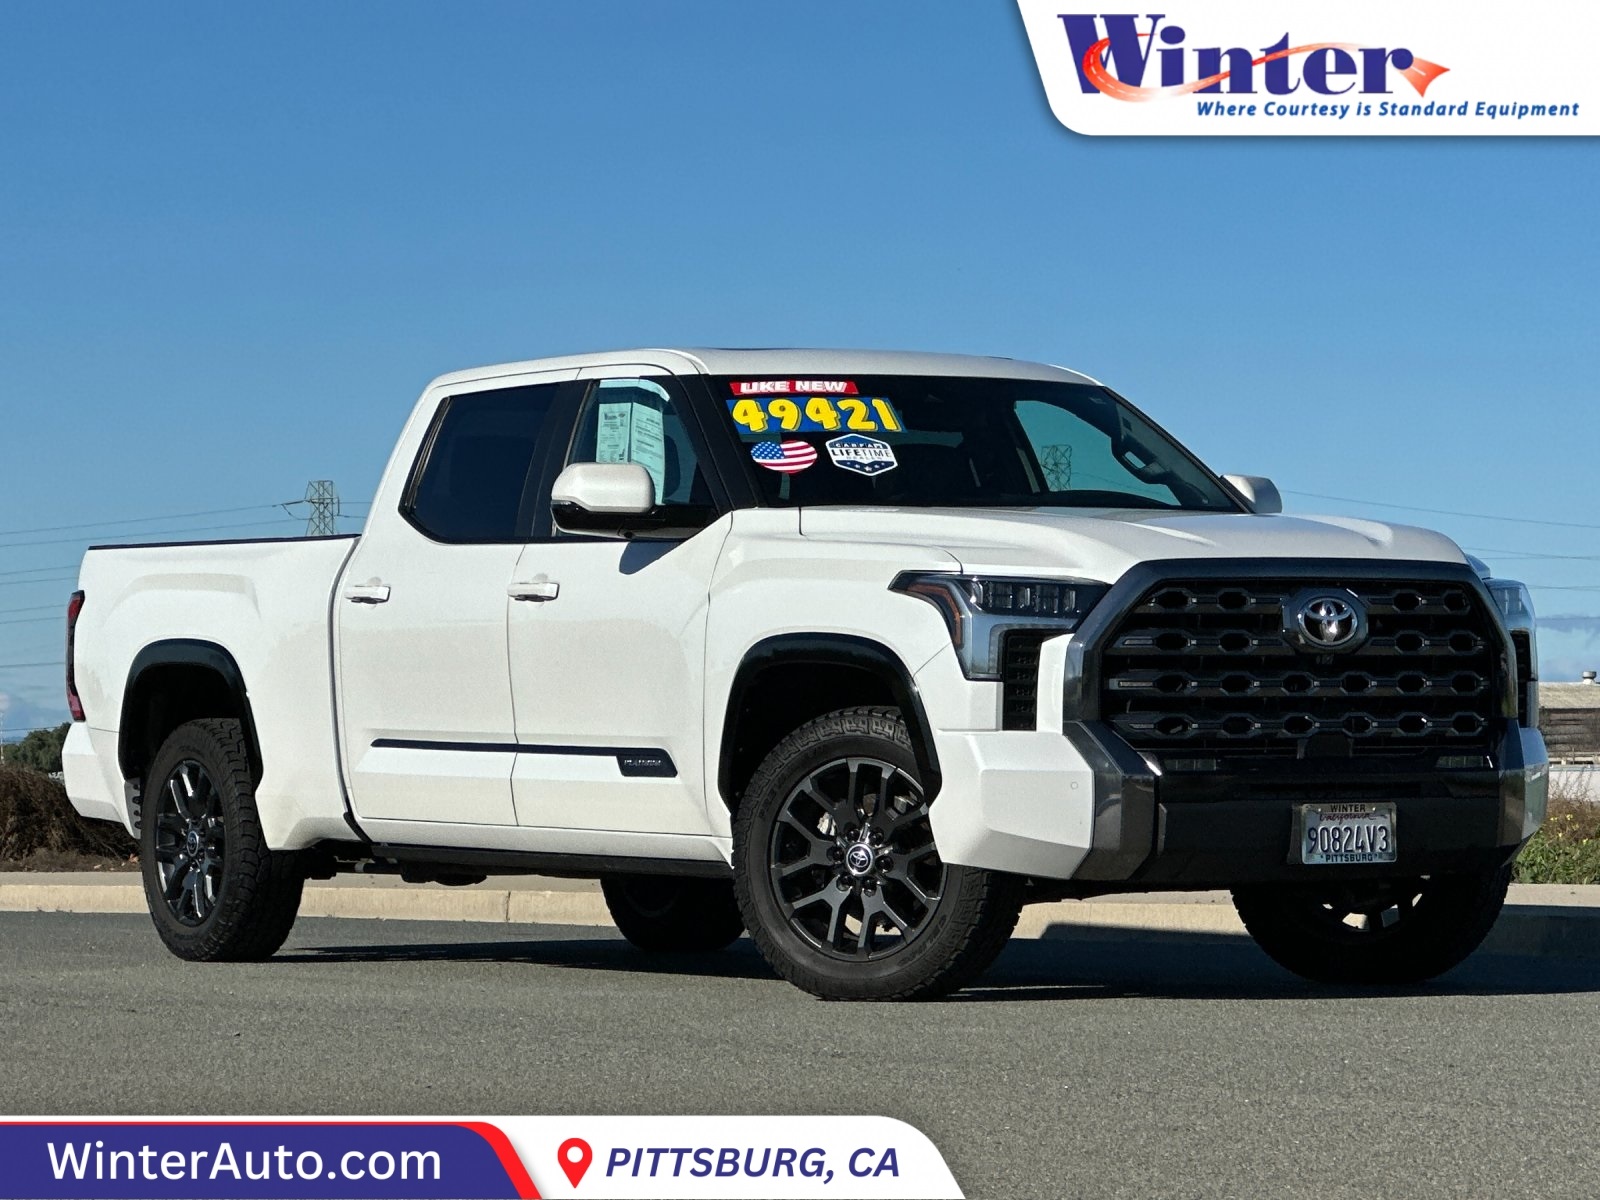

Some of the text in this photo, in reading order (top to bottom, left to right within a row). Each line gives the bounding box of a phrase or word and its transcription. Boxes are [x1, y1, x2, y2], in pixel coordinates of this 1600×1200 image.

[740, 381, 847, 394] LIKE NEW
[732, 397, 901, 432] 49421
[831, 449, 893, 458] LIFETIME
[1330, 804, 1366, 812] WINTER
[1307, 825, 1388, 853] 90824V3
[1325, 853, 1373, 862] PITTSBURG
